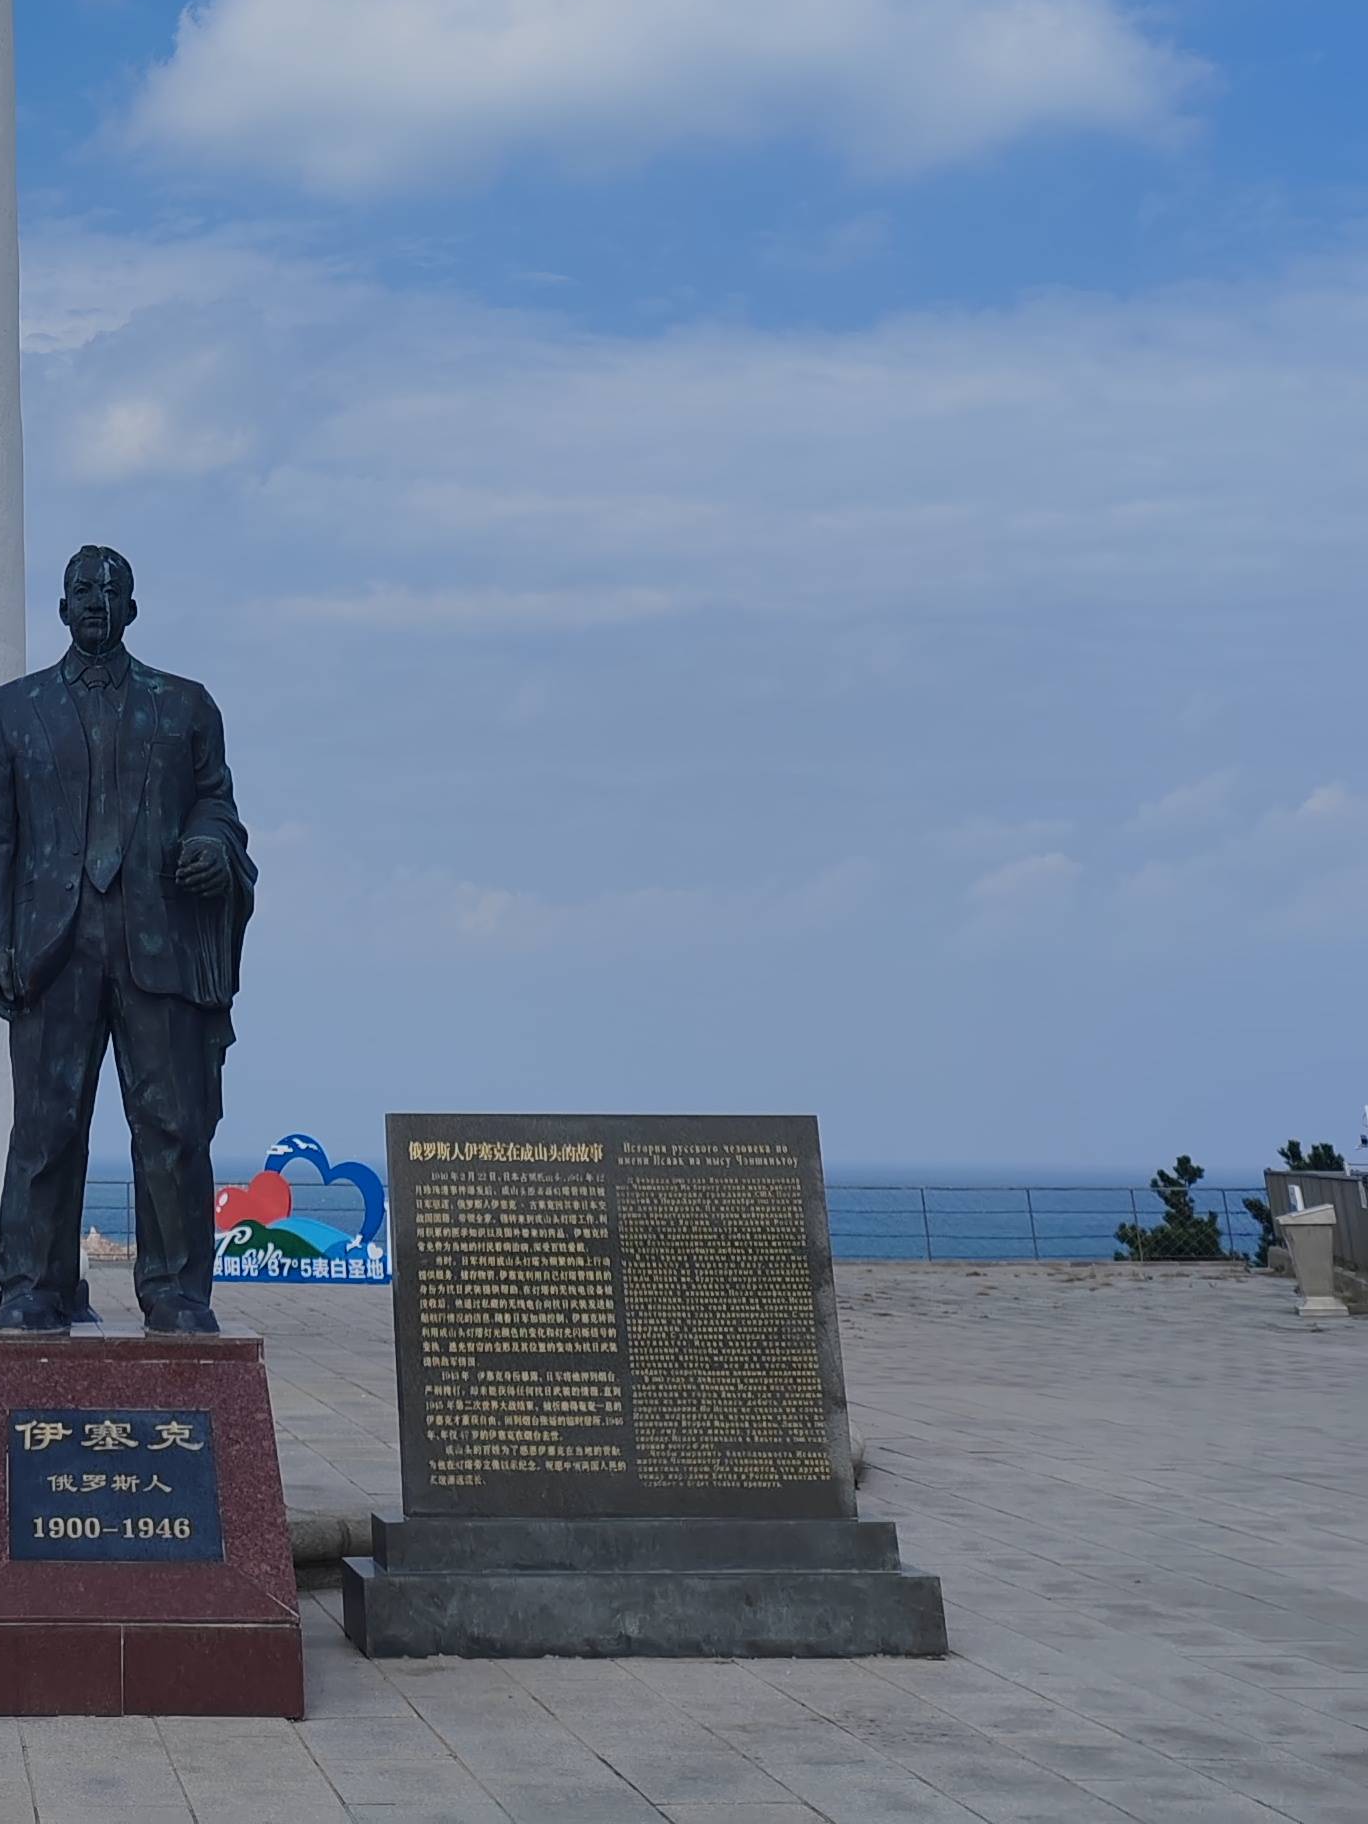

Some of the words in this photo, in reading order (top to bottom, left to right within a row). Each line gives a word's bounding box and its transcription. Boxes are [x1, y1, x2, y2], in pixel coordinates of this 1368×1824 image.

[408, 1141, 603, 1163] 俄罗斯人伊塞克在成山头的故事
[672, 1144, 719, 1156] русского
[15, 1420, 205, 1451] 伊塞克
[47, 1474, 173, 1494] 俄罗斯人
